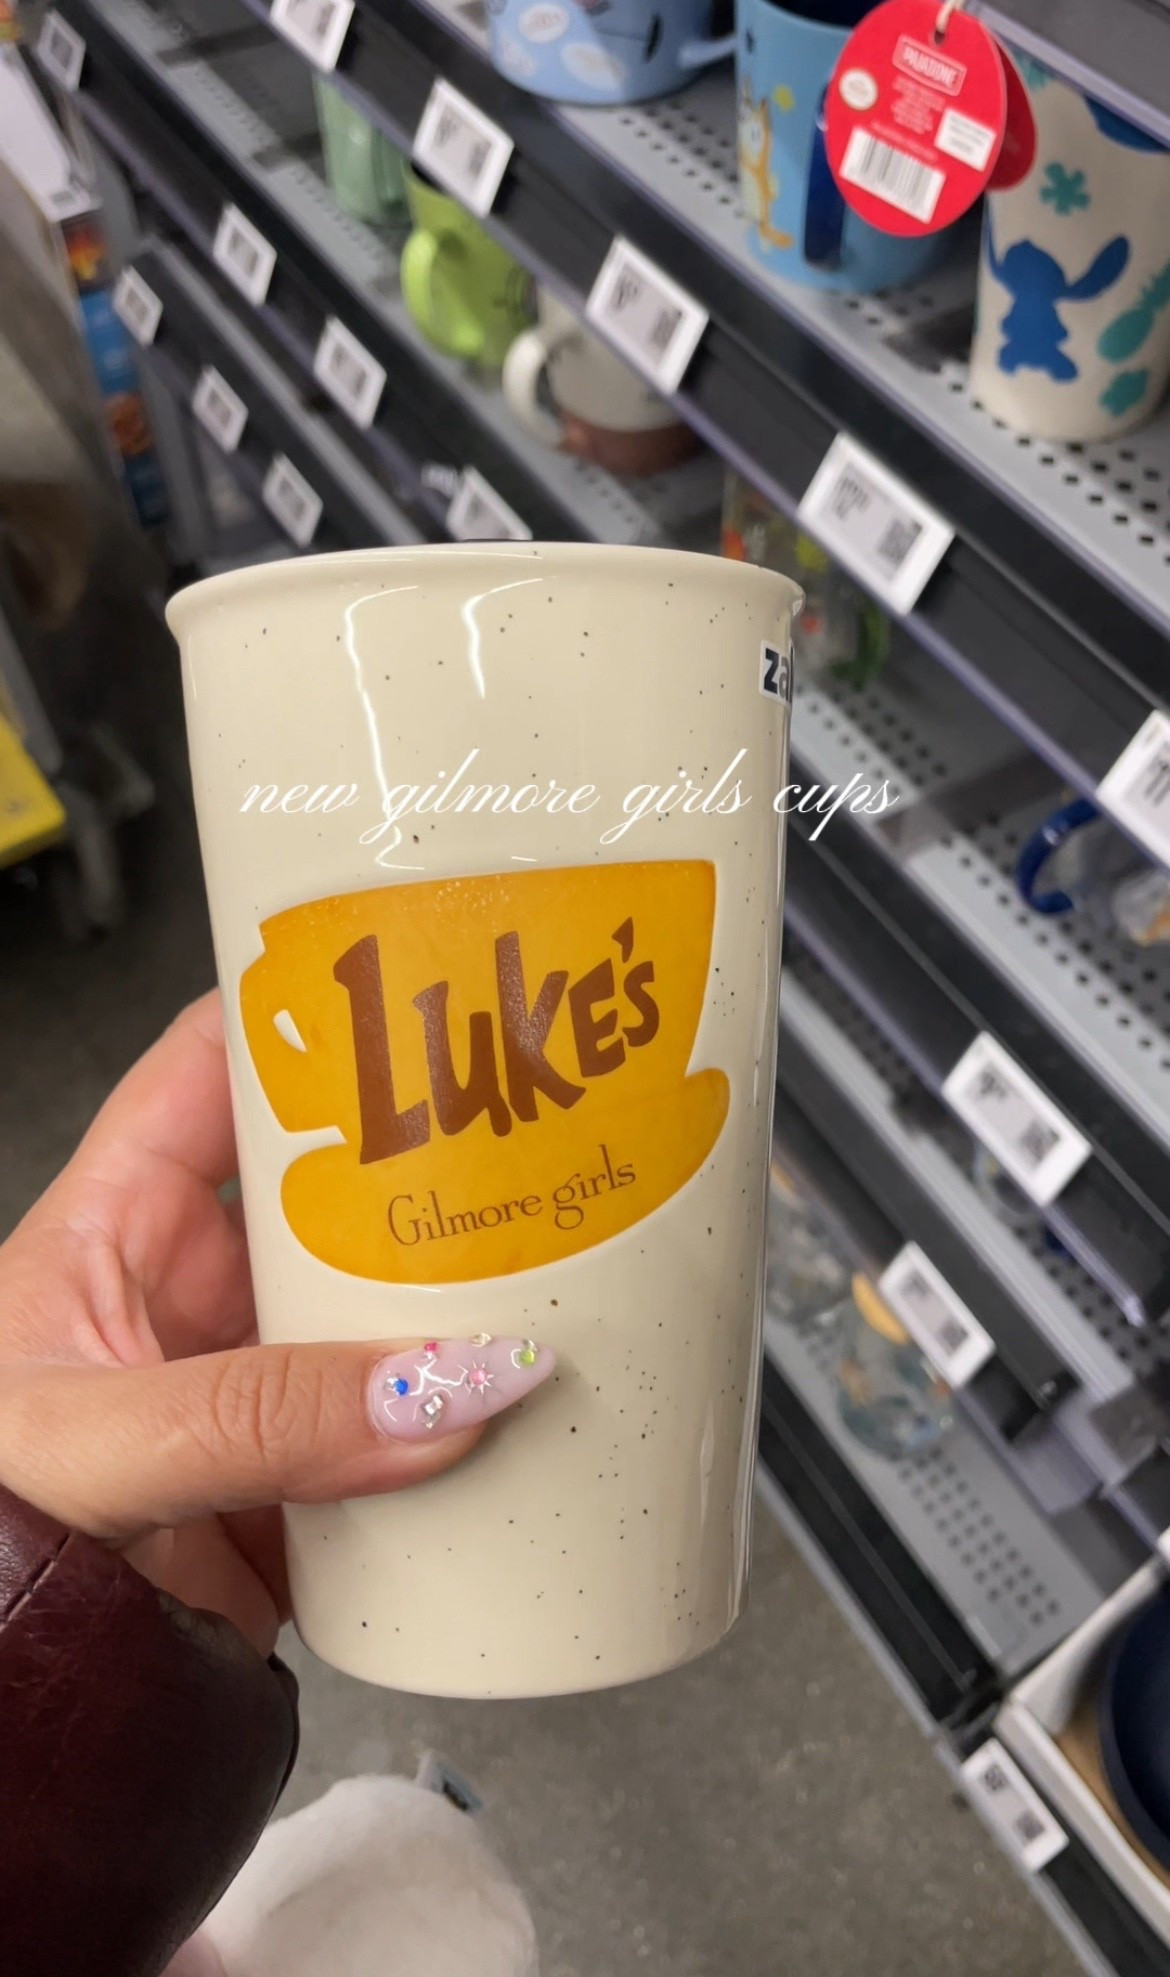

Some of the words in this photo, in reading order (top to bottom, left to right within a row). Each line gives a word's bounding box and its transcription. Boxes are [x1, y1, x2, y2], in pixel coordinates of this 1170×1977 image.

[763, 647, 794, 702] za
[388, 1190, 543, 1246] Gilmore
[552, 1143, 636, 1230] girls
